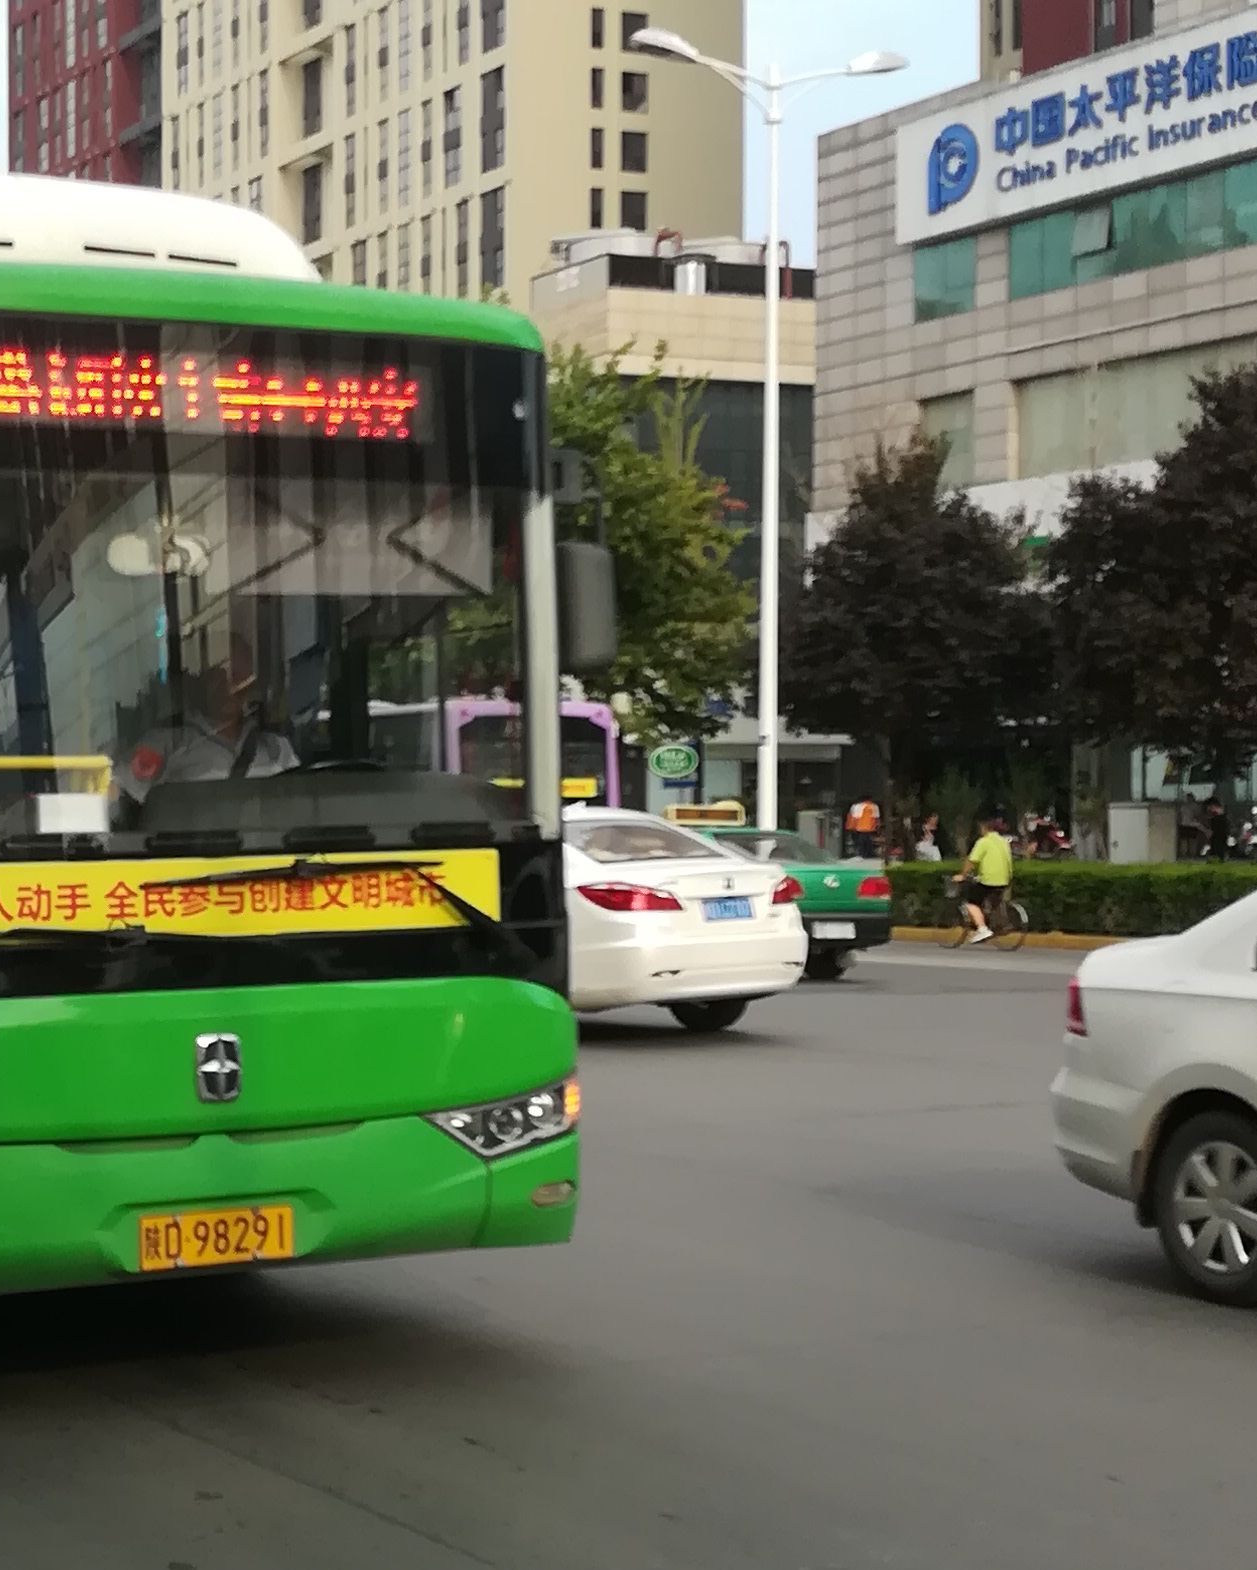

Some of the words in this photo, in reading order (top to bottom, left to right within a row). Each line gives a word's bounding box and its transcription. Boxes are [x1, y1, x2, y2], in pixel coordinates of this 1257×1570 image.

[994, 31, 1257, 156] 中国太平洋保险
[996, 160, 1057, 192] China
[1065, 133, 1140, 174] Pacific
